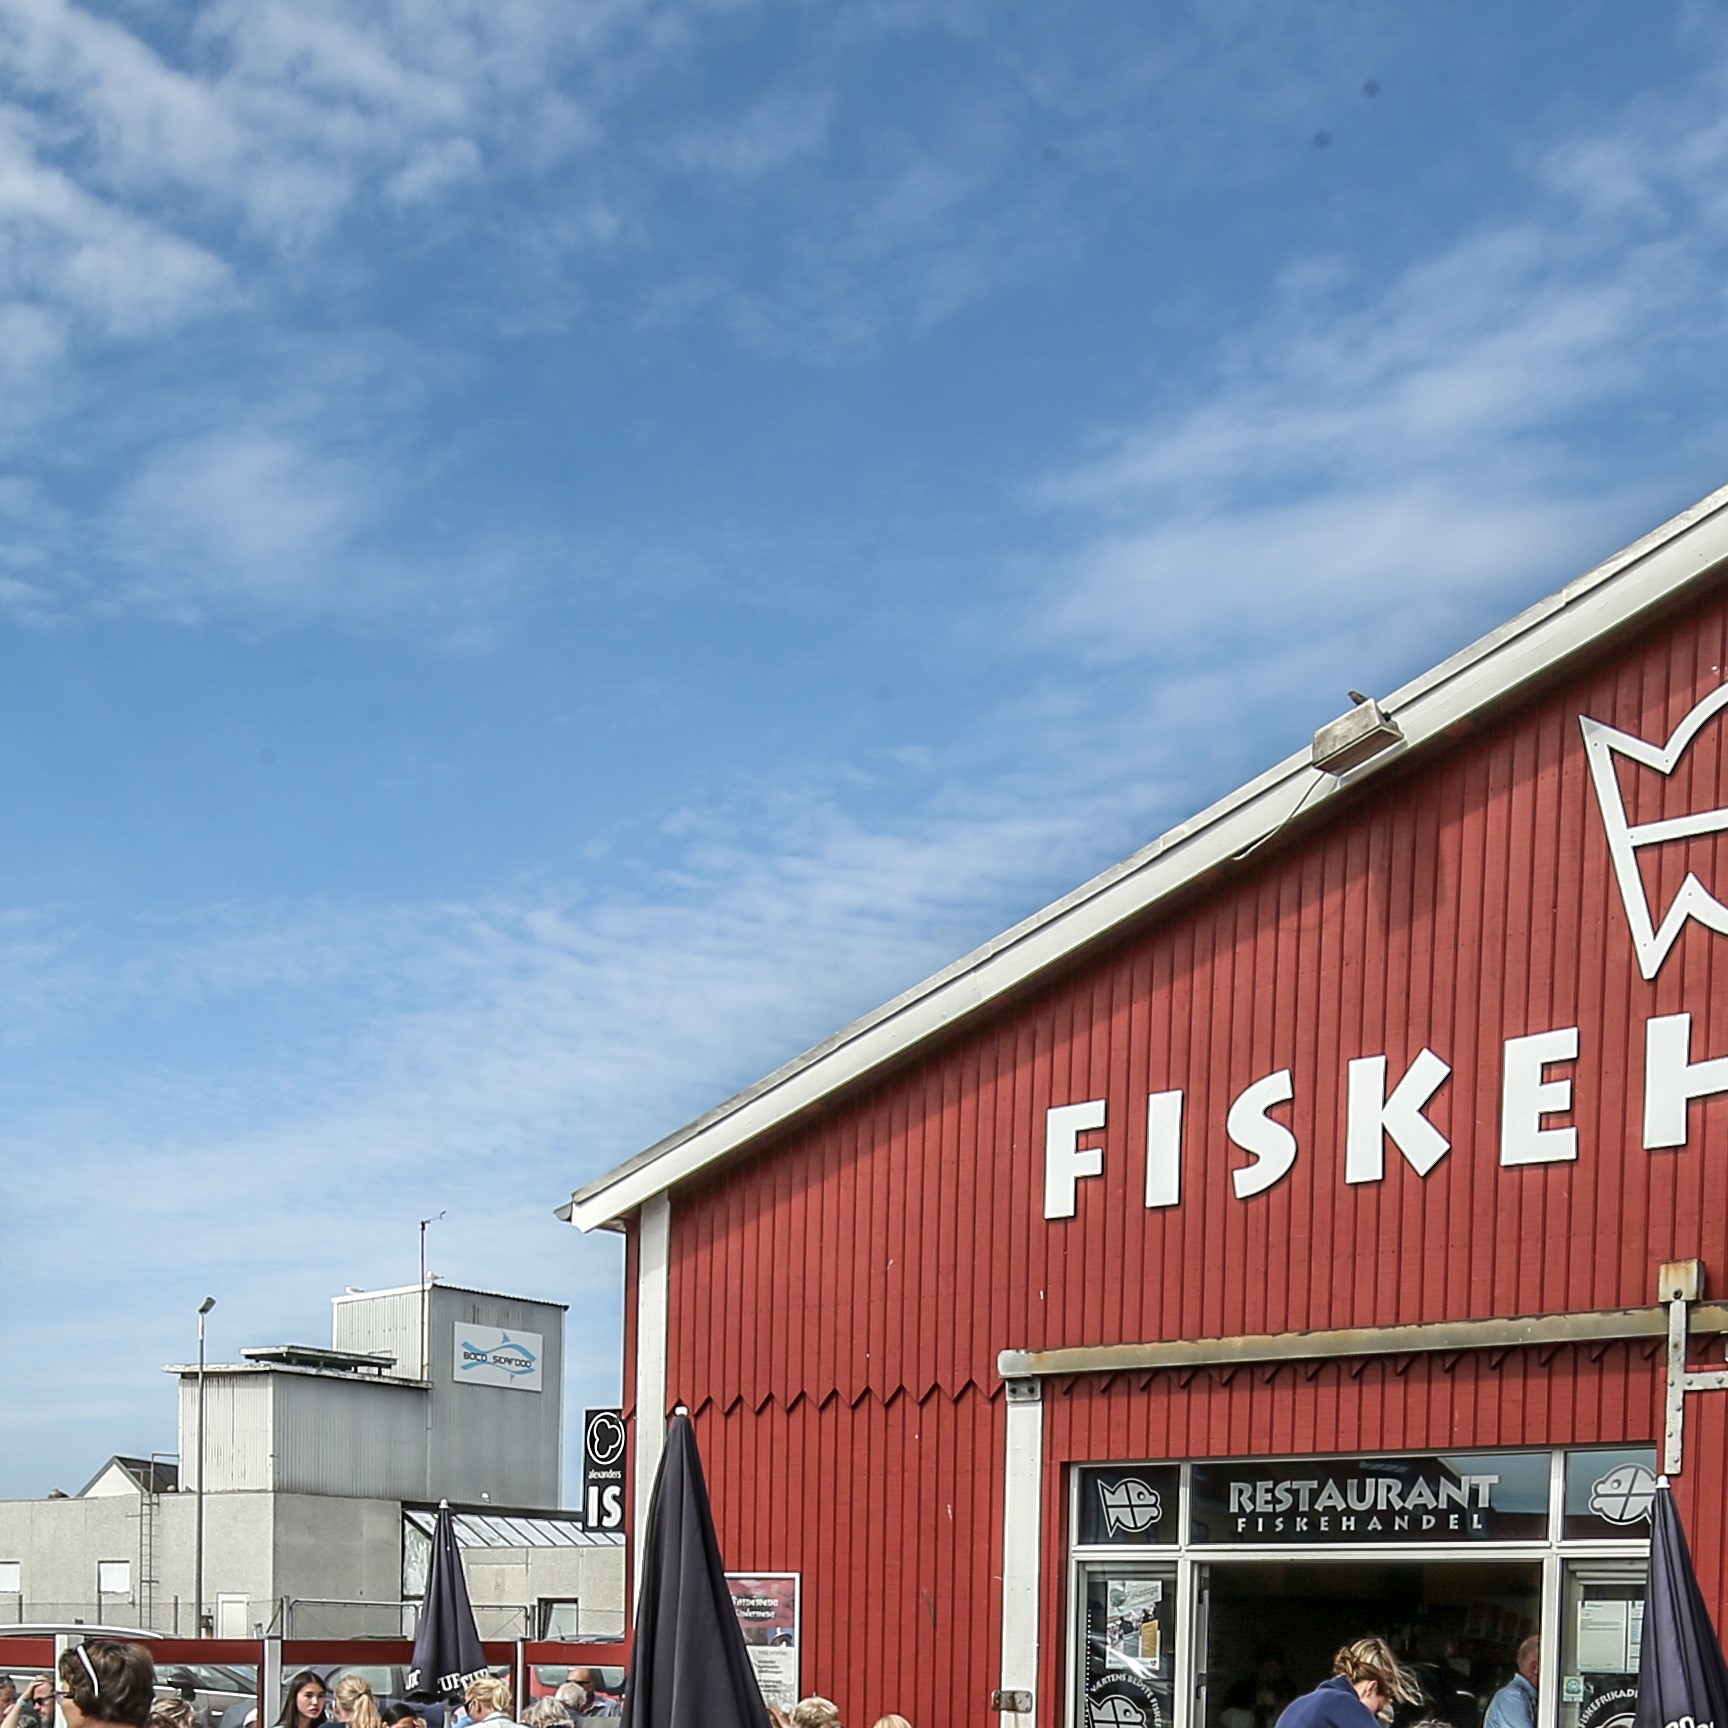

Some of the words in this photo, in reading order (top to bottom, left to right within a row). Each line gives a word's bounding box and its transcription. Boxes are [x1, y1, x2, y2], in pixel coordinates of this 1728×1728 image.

[463, 1351, 488, 1363] BOCO
[492, 1354, 532, 1368] SEAFOOD
[588, 1485, 623, 1528] IS
[1229, 1475, 1499, 1513] RESTAURANT
[1237, 1513, 1484, 1533] FISKEHANDEL
